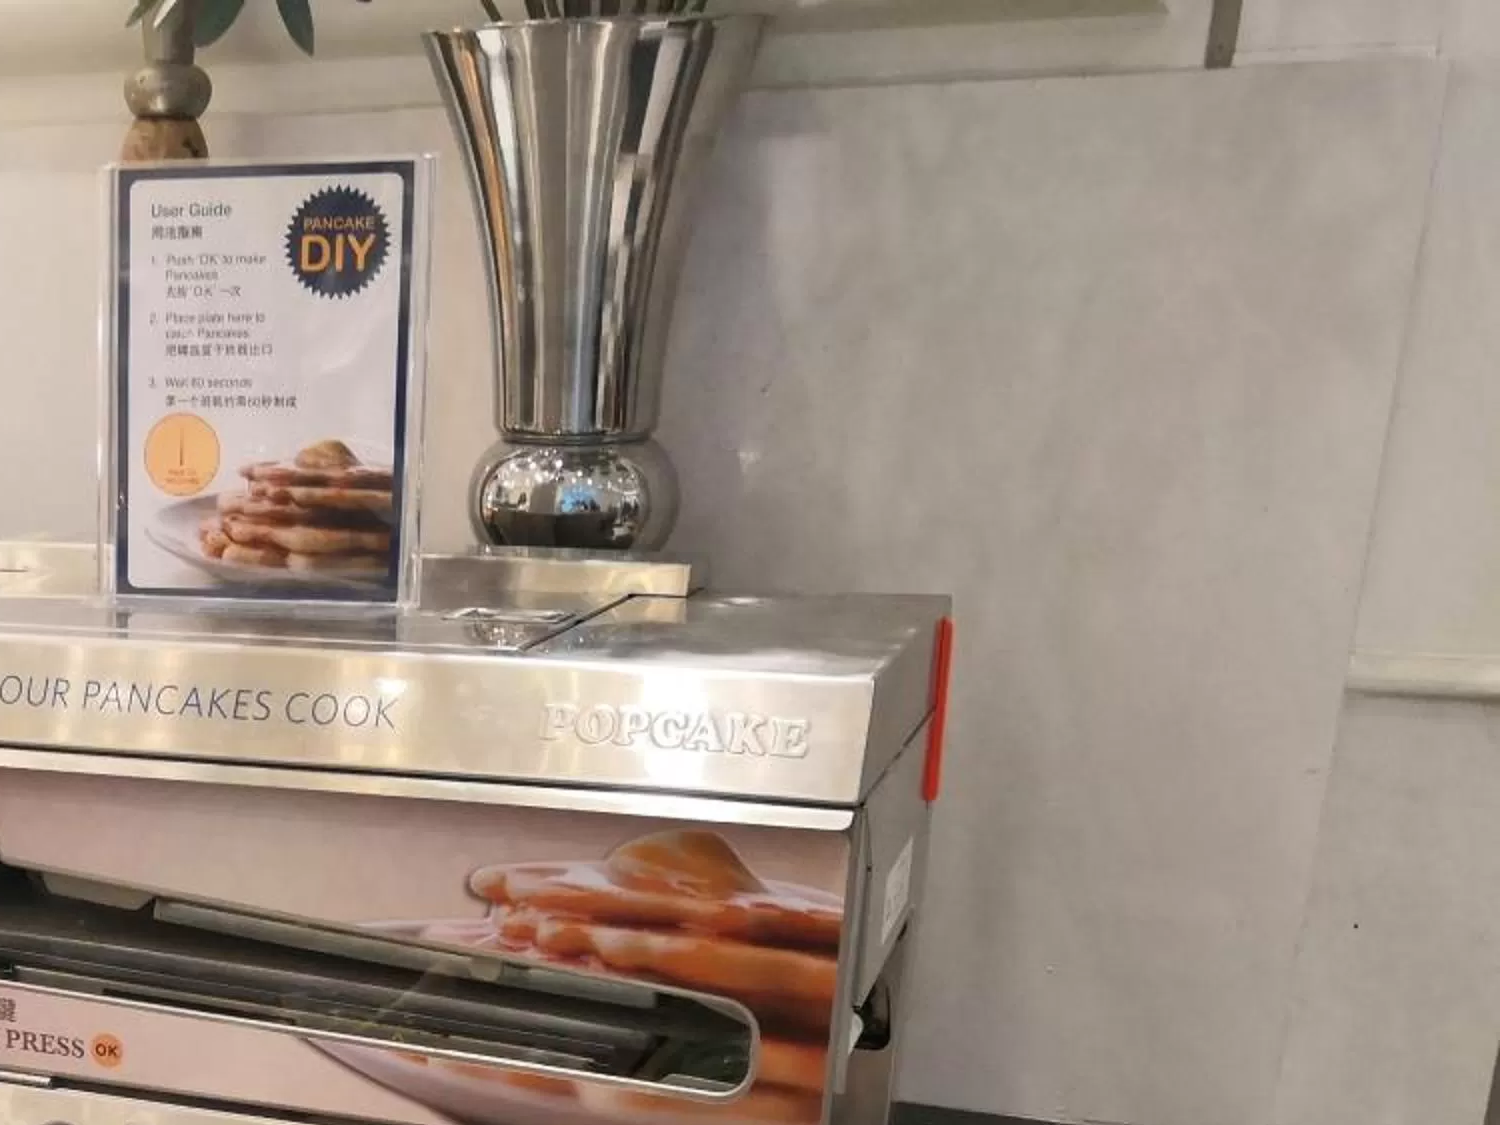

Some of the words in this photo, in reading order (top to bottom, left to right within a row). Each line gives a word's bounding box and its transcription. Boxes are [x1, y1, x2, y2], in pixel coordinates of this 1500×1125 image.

[151, 203, 184, 218] User
[188, 202, 233, 218] Guide
[303, 215, 376, 231] PANCAKE
[236, 254, 267, 265] make
[301, 232, 377, 273] DIY
[207, 376, 253, 388] seconds
[82, 678, 271, 723] PANCAKES
[285, 691, 400, 731] COOK
[538, 702, 812, 759] POPCAKE
[6, 1028, 86, 1059] PRESS
[94, 1043, 120, 1058] OK
